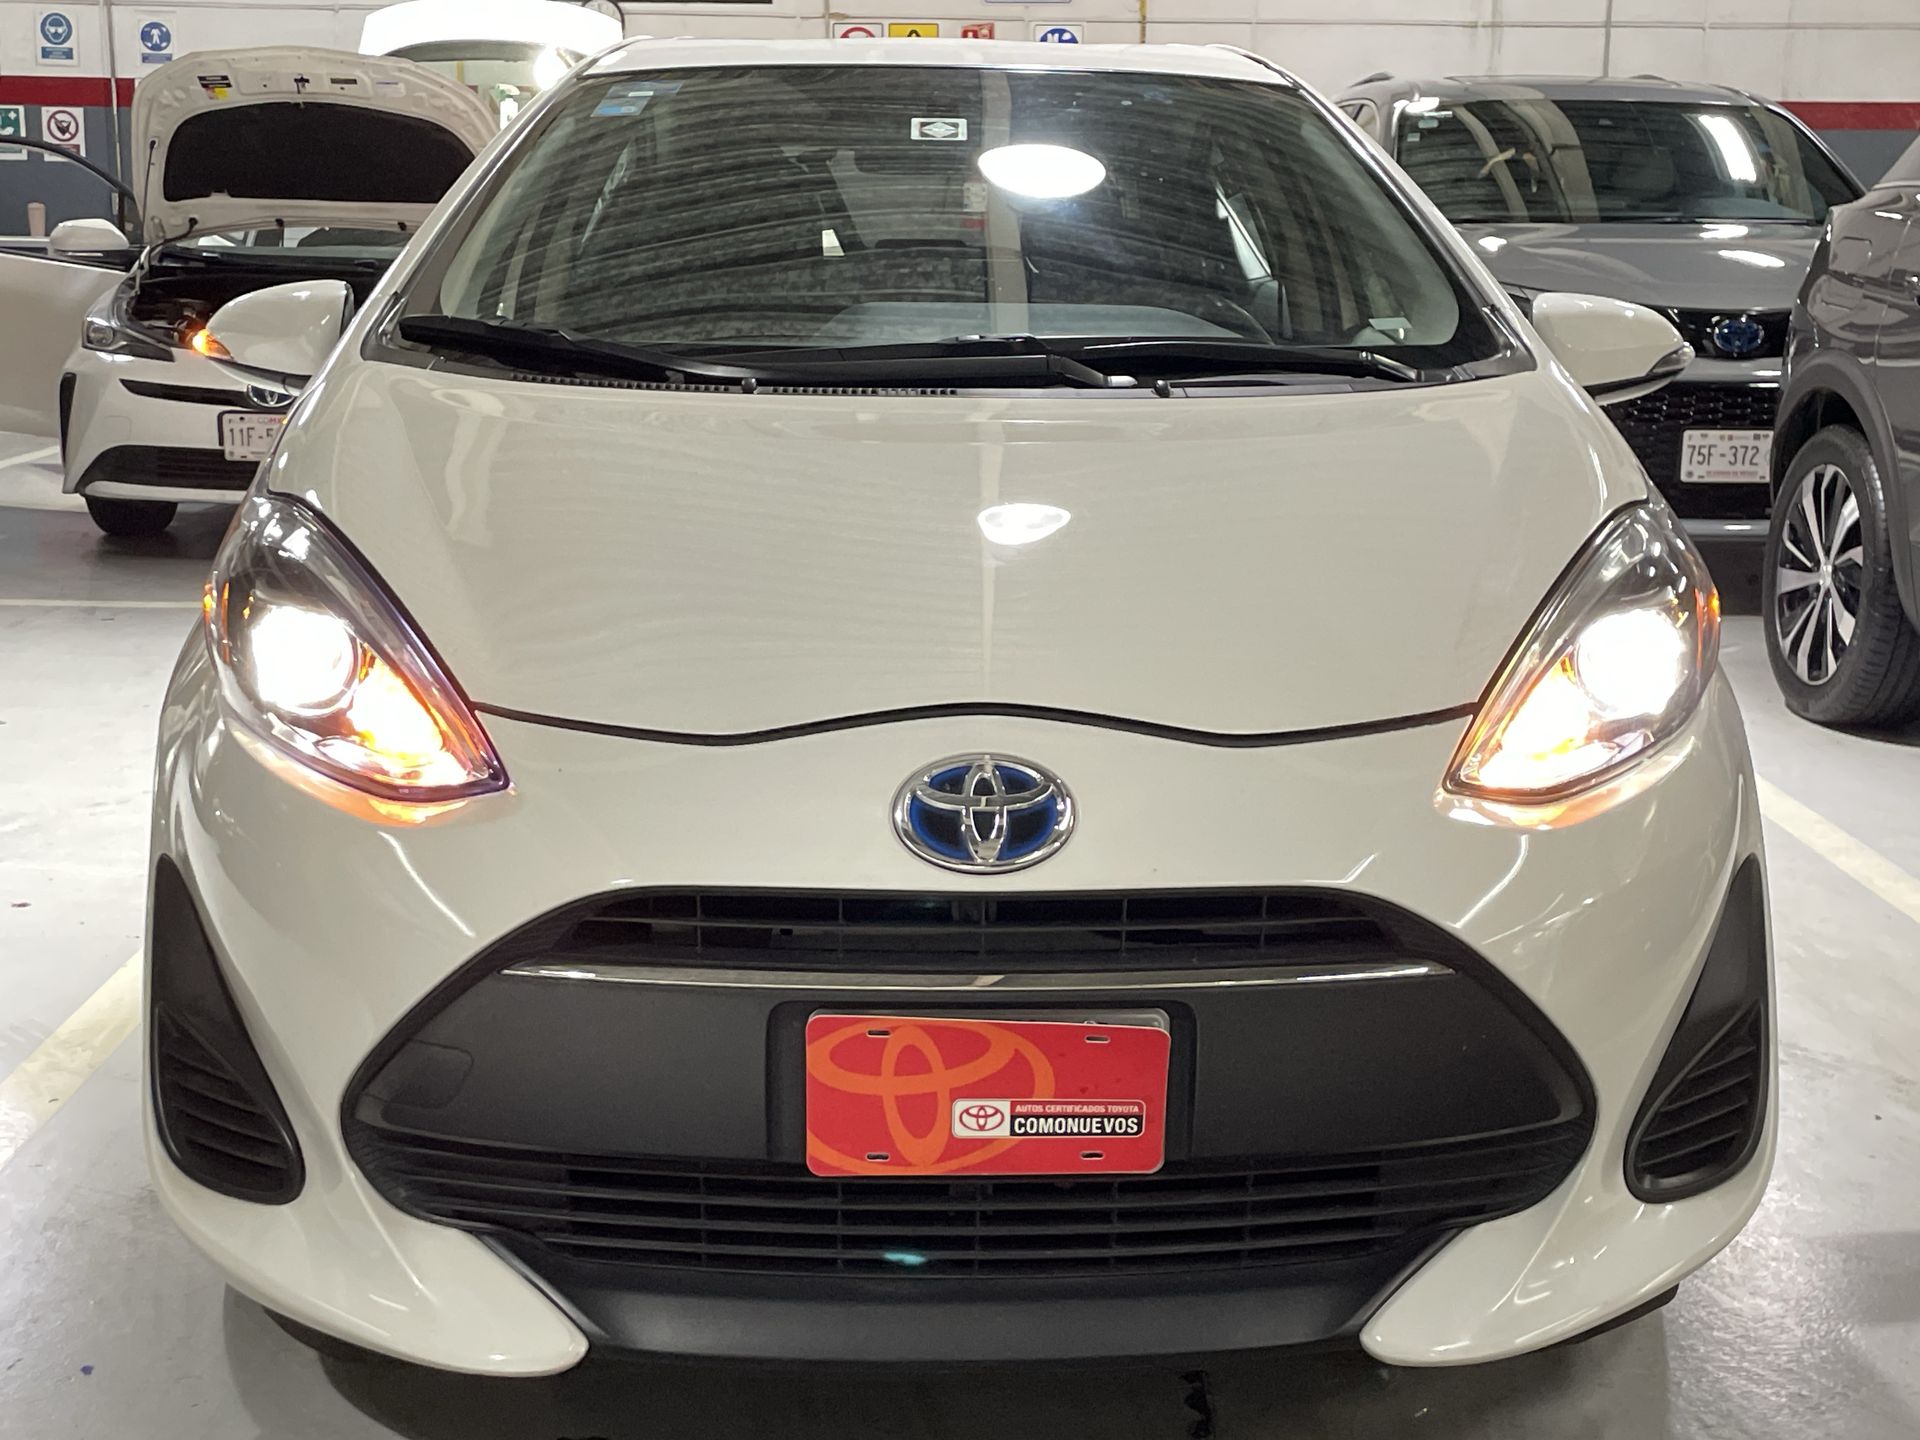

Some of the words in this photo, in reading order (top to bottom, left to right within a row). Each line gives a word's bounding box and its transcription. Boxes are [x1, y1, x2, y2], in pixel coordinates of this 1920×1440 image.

[1687, 444, 1760, 466] 75F-372
[1015, 1104, 1044, 1113] AUTOS
[1045, 1104, 1106, 1113] CERTIFICADOS
[1107, 1105, 1139, 1113] TOYOTA
[1014, 1117, 1138, 1134] COMONUEVOS
